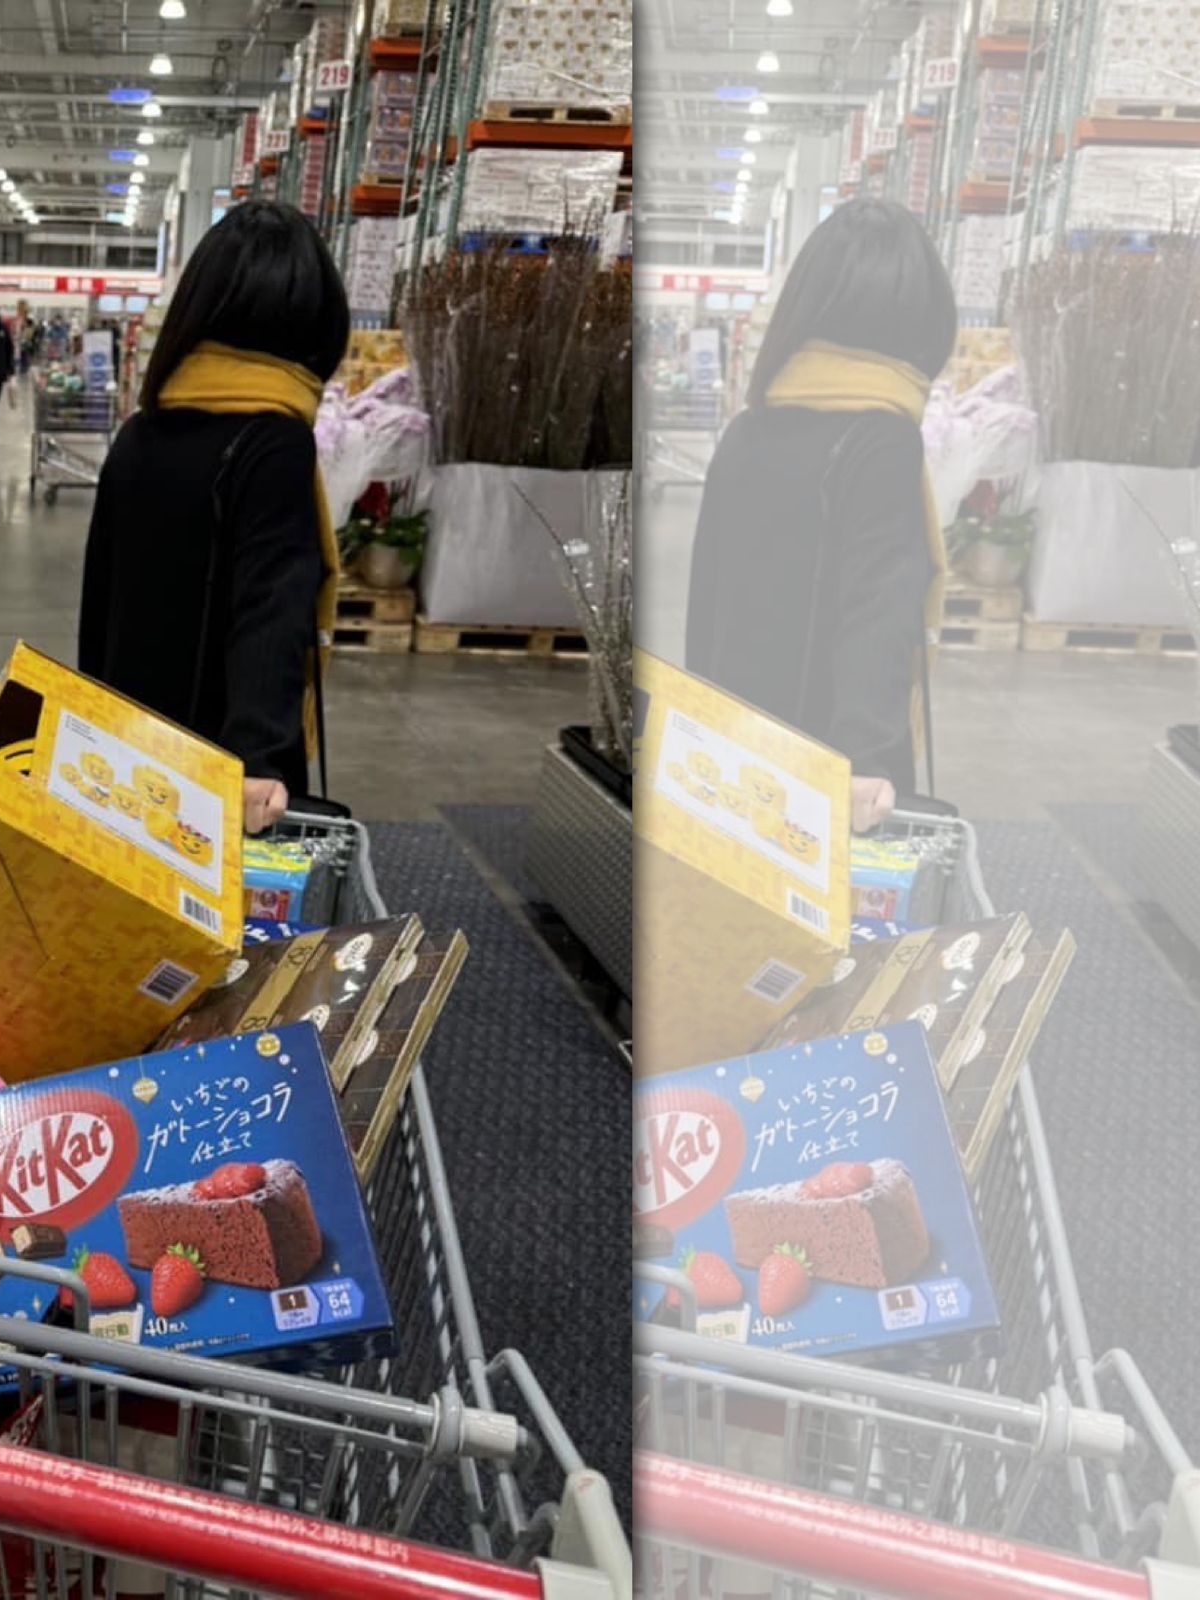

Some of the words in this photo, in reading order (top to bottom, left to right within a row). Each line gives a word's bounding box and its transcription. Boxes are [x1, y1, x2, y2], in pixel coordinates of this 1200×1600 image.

[321, 65, 349, 86] 219
[171, 1076, 250, 1113] いちごの
[778, 1075, 857, 1112] いちごの
[143, 1081, 292, 1174] ガトーショコラ
[191, 1131, 252, 1165] 仕立て
[798, 1130, 859, 1164] 仕立て
